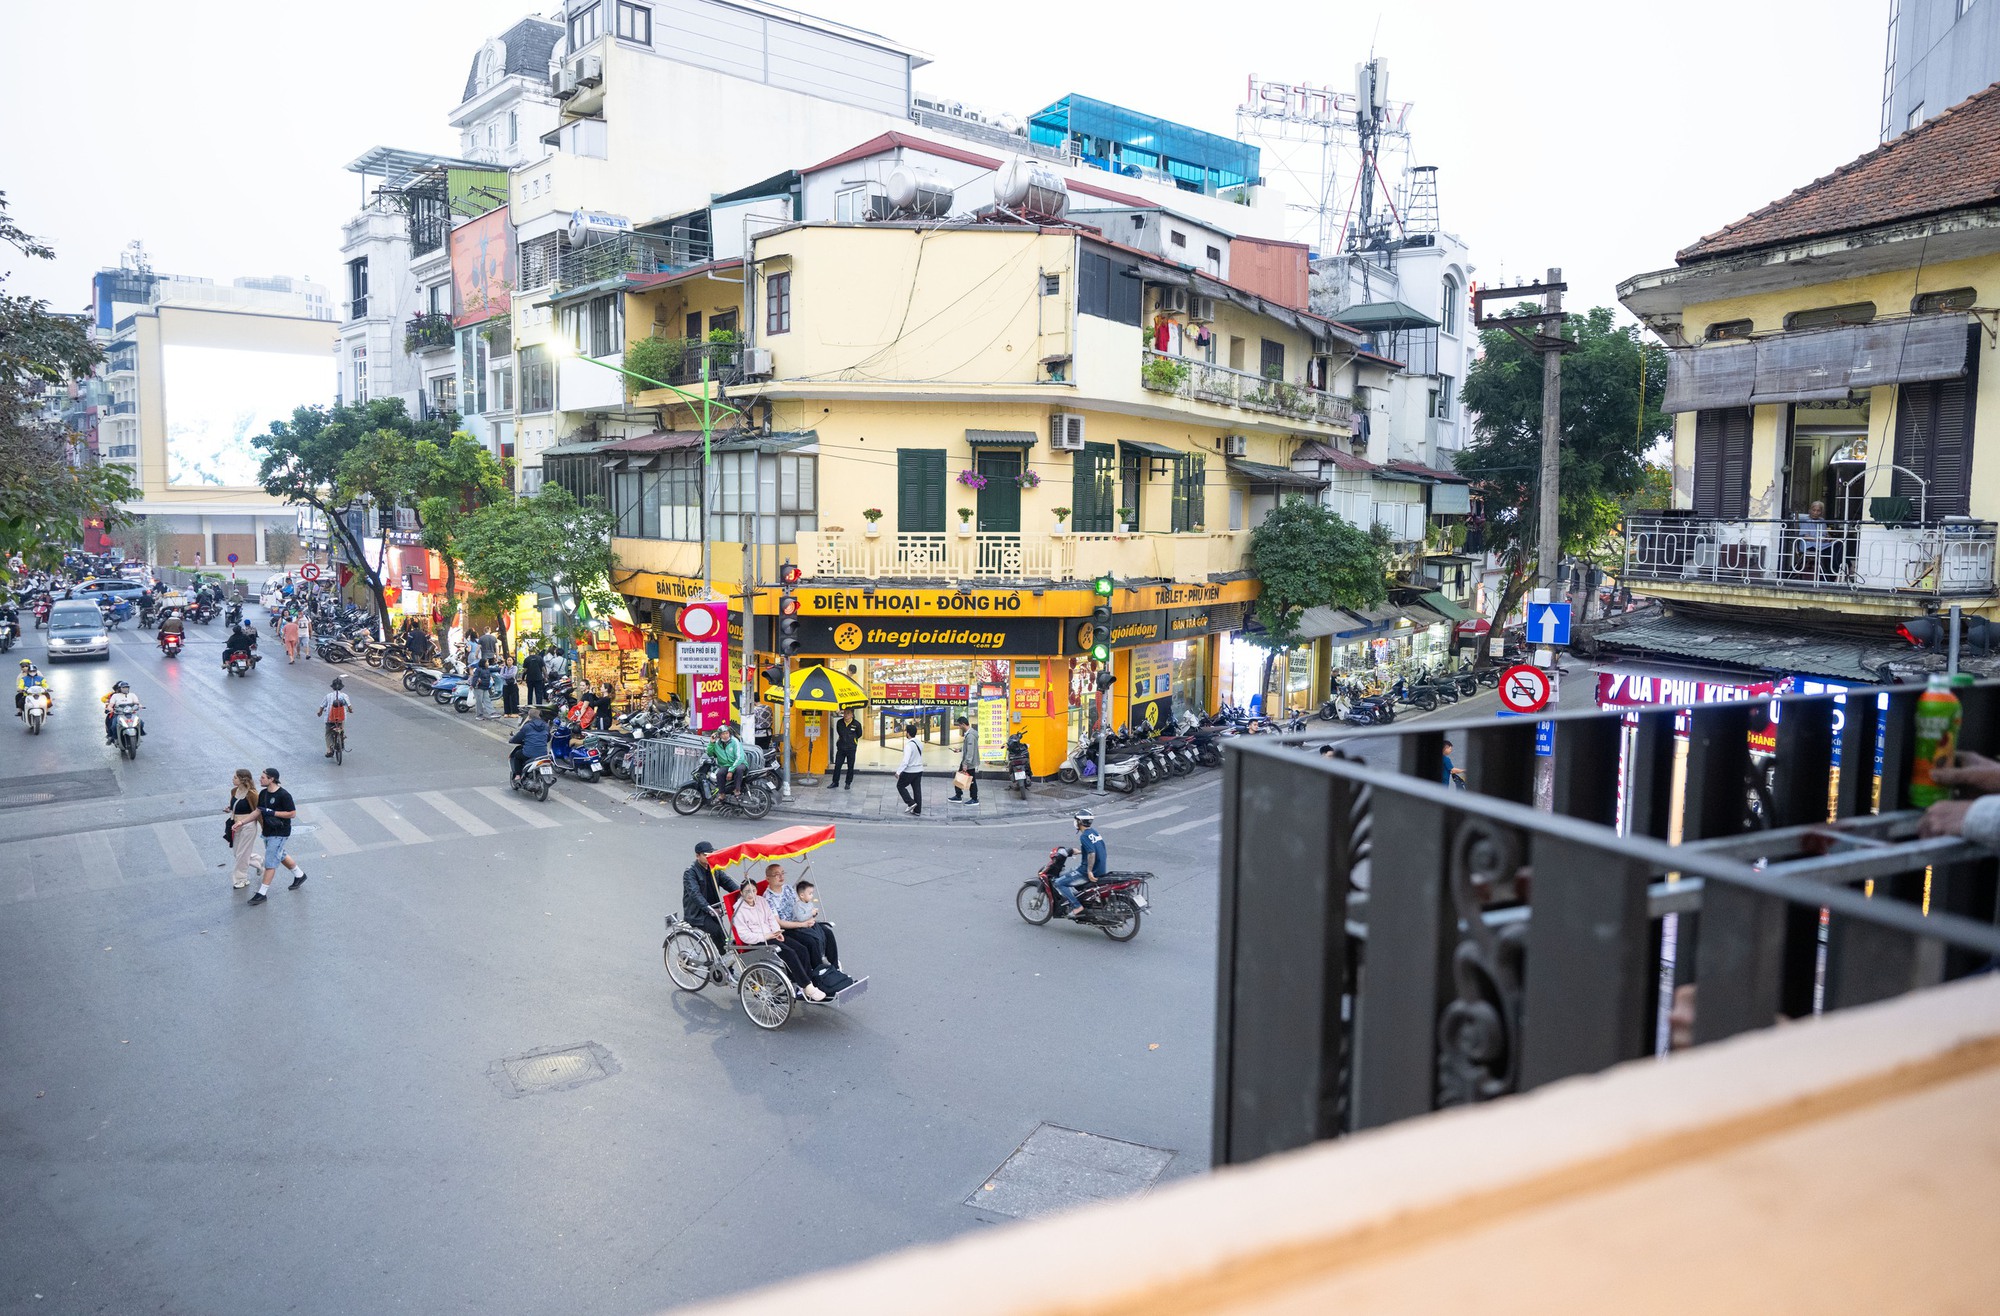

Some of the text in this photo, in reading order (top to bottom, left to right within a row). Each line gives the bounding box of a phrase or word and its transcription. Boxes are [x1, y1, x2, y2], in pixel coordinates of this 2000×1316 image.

[656, 579, 671, 595] BÁN
[1155, 589, 1184, 605] TABLET
[1187, 588, 1203, 604] PHỤ
[1203, 585, 1220, 604] KIỆN
[813, 592, 858, 613] ĐIỆN
[863, 595, 920, 613] THOẠI
[937, 589, 990, 610] ĐỒNG
[994, 590, 1021, 610] HỒ
[867, 628, 1006, 648] thegioididong
[1110, 624, 1158, 643] gioididong
[701, 680, 724, 693] 2026
